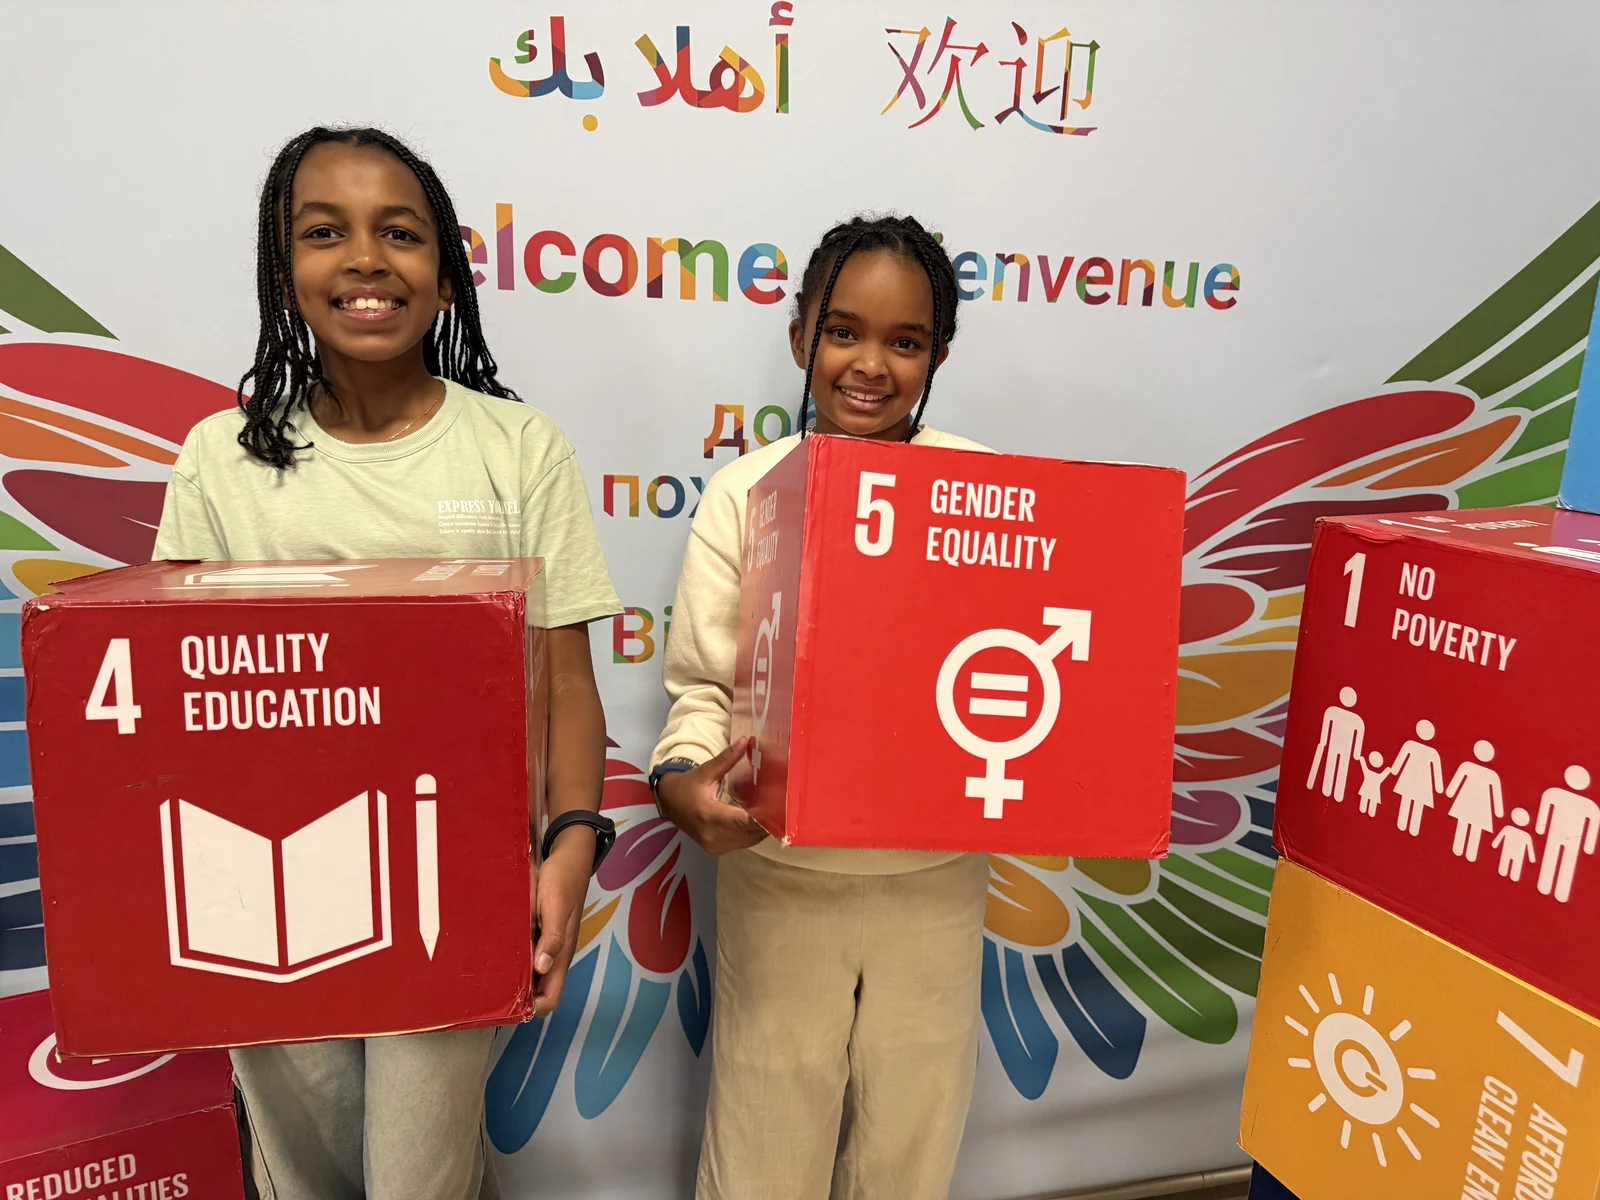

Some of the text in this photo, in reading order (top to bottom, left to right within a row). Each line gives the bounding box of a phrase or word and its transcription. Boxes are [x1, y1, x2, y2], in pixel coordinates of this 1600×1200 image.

[488, 1, 794, 132] أهلا بك
[881, 16, 1100, 136] 欢迎
[437, 499, 486, 513] EXPRESS
[854, 470, 897, 557] 5
[930, 479, 1036, 523] GENDER
[926, 526, 1057, 571] EQUALITY
[1343, 552, 1367, 628] 1
[1399, 562, 1436, 601] NO
[181, 632, 329, 679] QUALITY
[1391, 608, 1517, 672] POVERTY
[85, 638, 142, 735] 4
[184, 686, 381, 731] EDUCATION
[1496, 1010, 1585, 1088] 7
[1461, 1076, 1518, 1200] CLEAN EN
[5, 1153, 137, 1200] REDUCED
